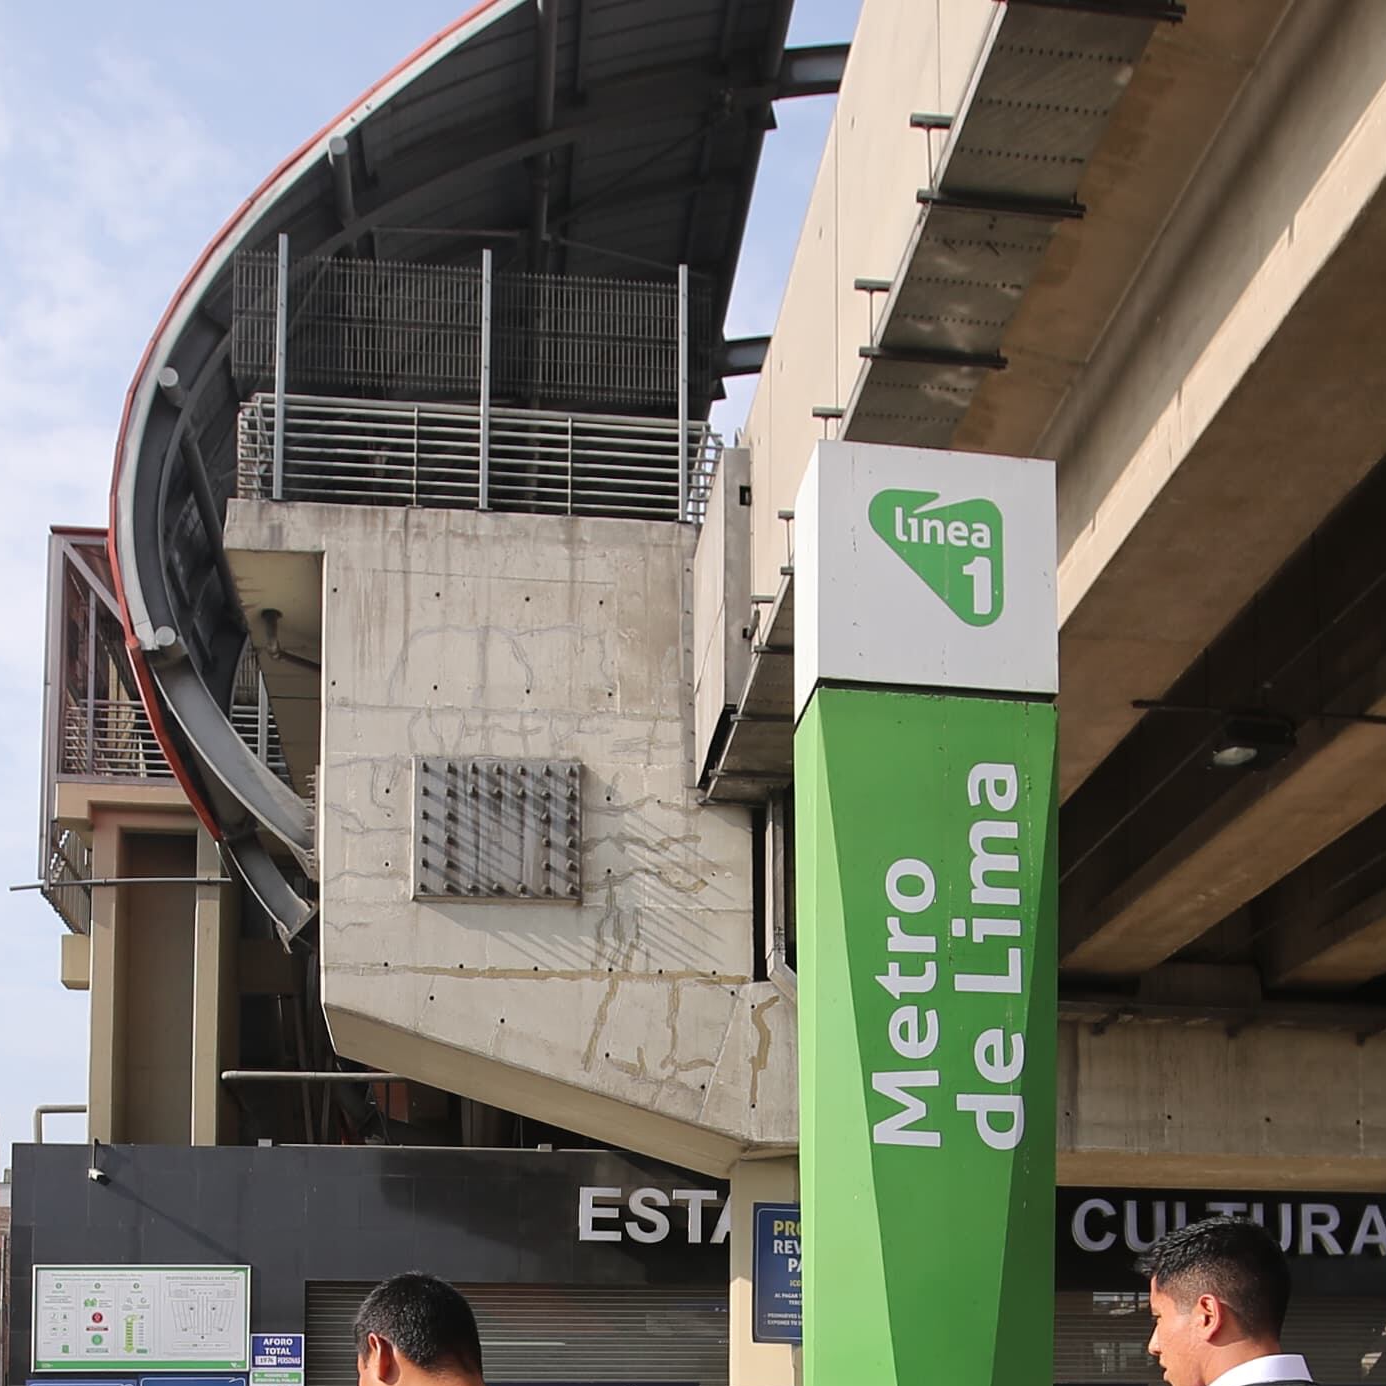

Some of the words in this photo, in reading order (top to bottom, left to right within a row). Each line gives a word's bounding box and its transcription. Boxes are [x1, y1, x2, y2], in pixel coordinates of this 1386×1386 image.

[962, 556, 992, 615] 1
[952, 762, 1022, 995] Lima
[871, 857, 941, 1149] Metro
[956, 1027, 1024, 1151] de
